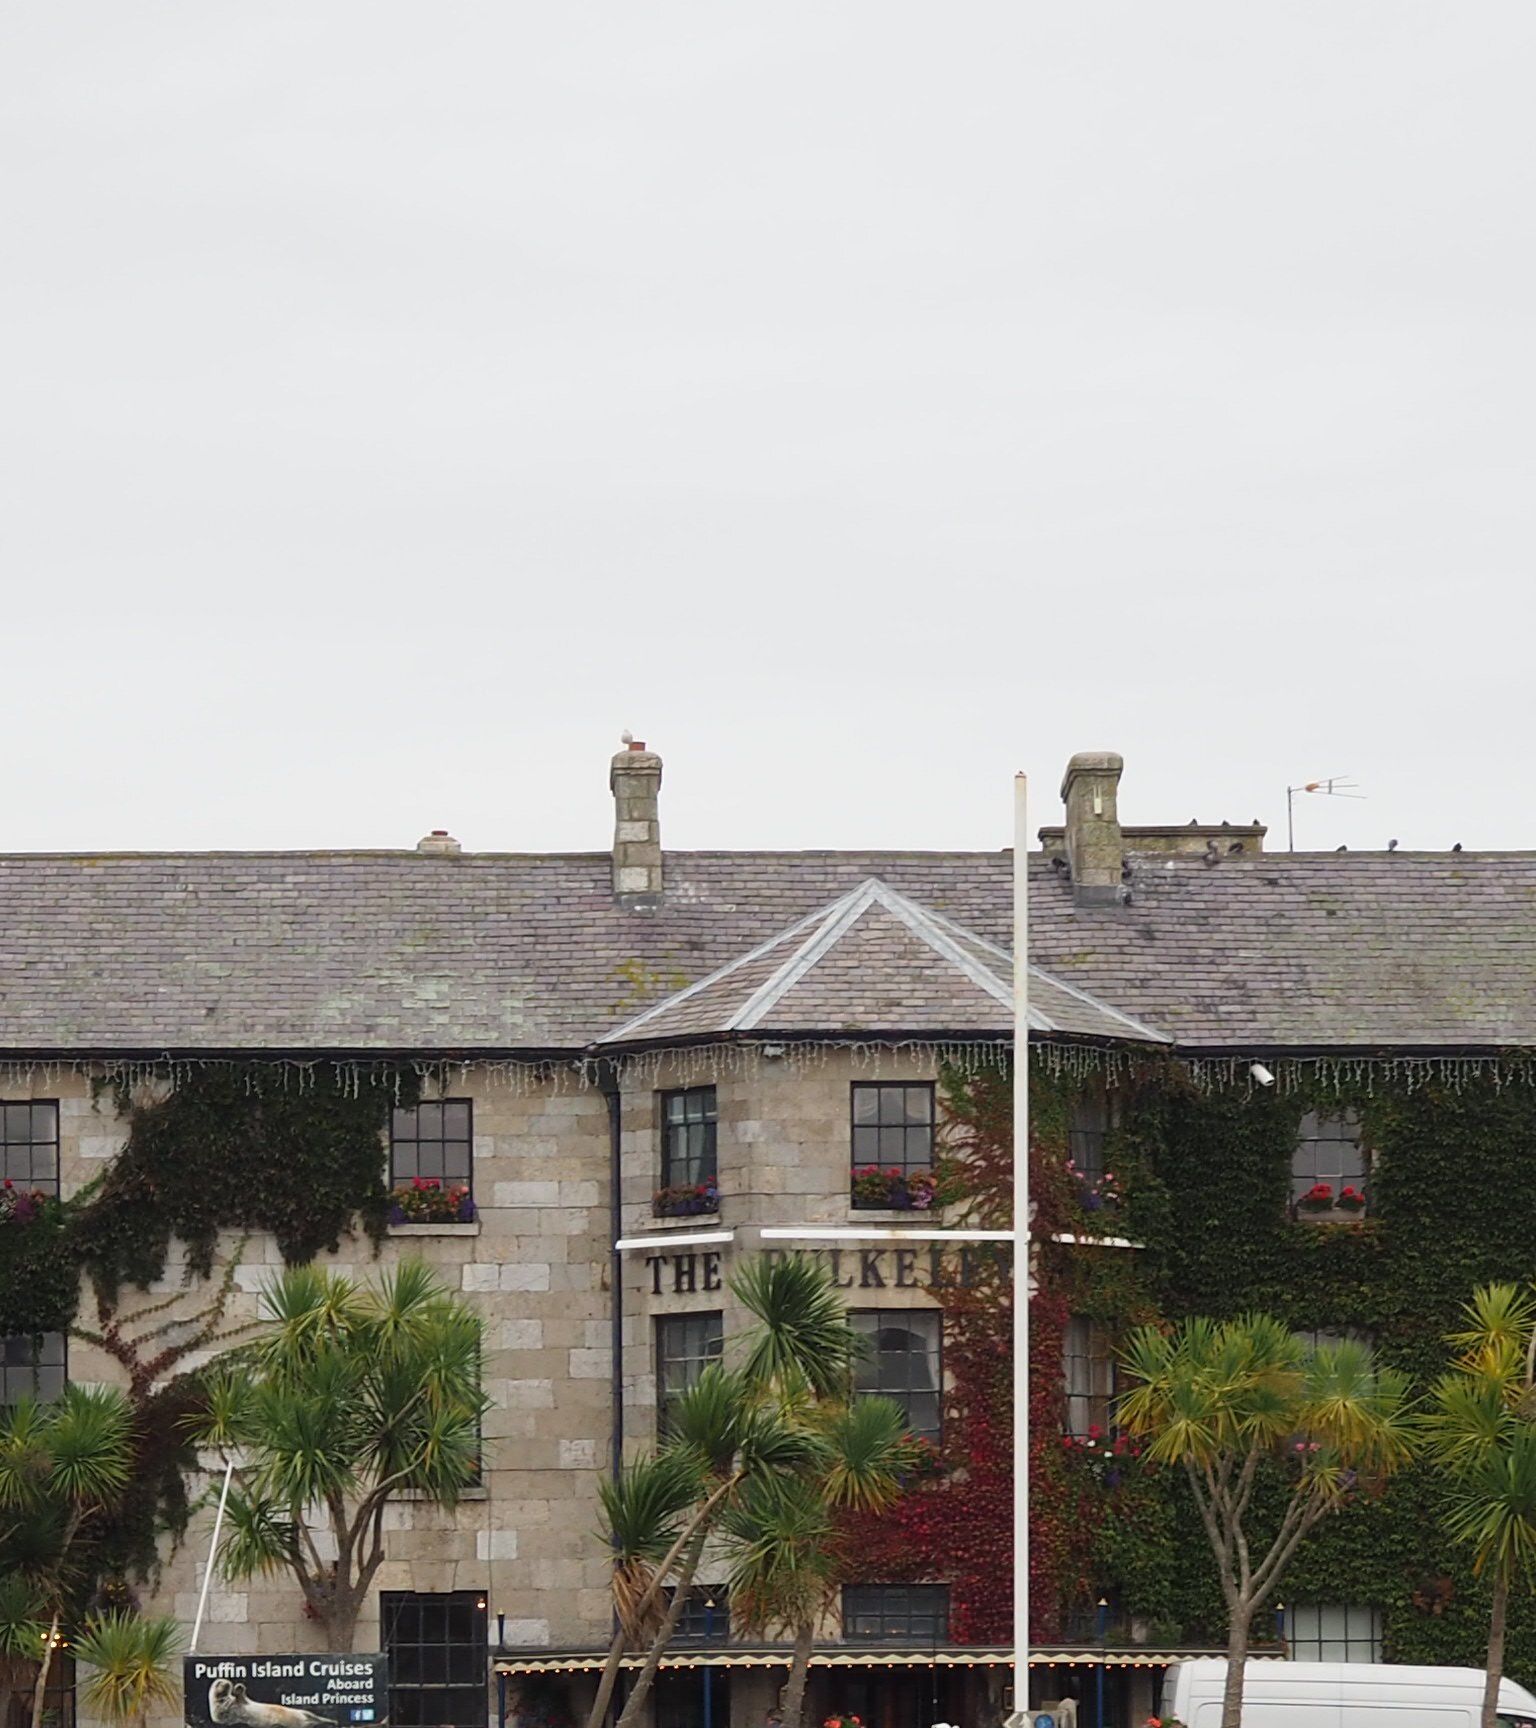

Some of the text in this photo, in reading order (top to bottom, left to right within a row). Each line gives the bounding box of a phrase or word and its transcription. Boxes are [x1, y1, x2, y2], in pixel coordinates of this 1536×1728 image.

[645, 1252, 722, 1295] THE
[195, 1659, 374, 1679] Puffin Island Cruises
[326, 1678, 374, 1690] Aboard
[280, 1692, 375, 1706] Island Princess
